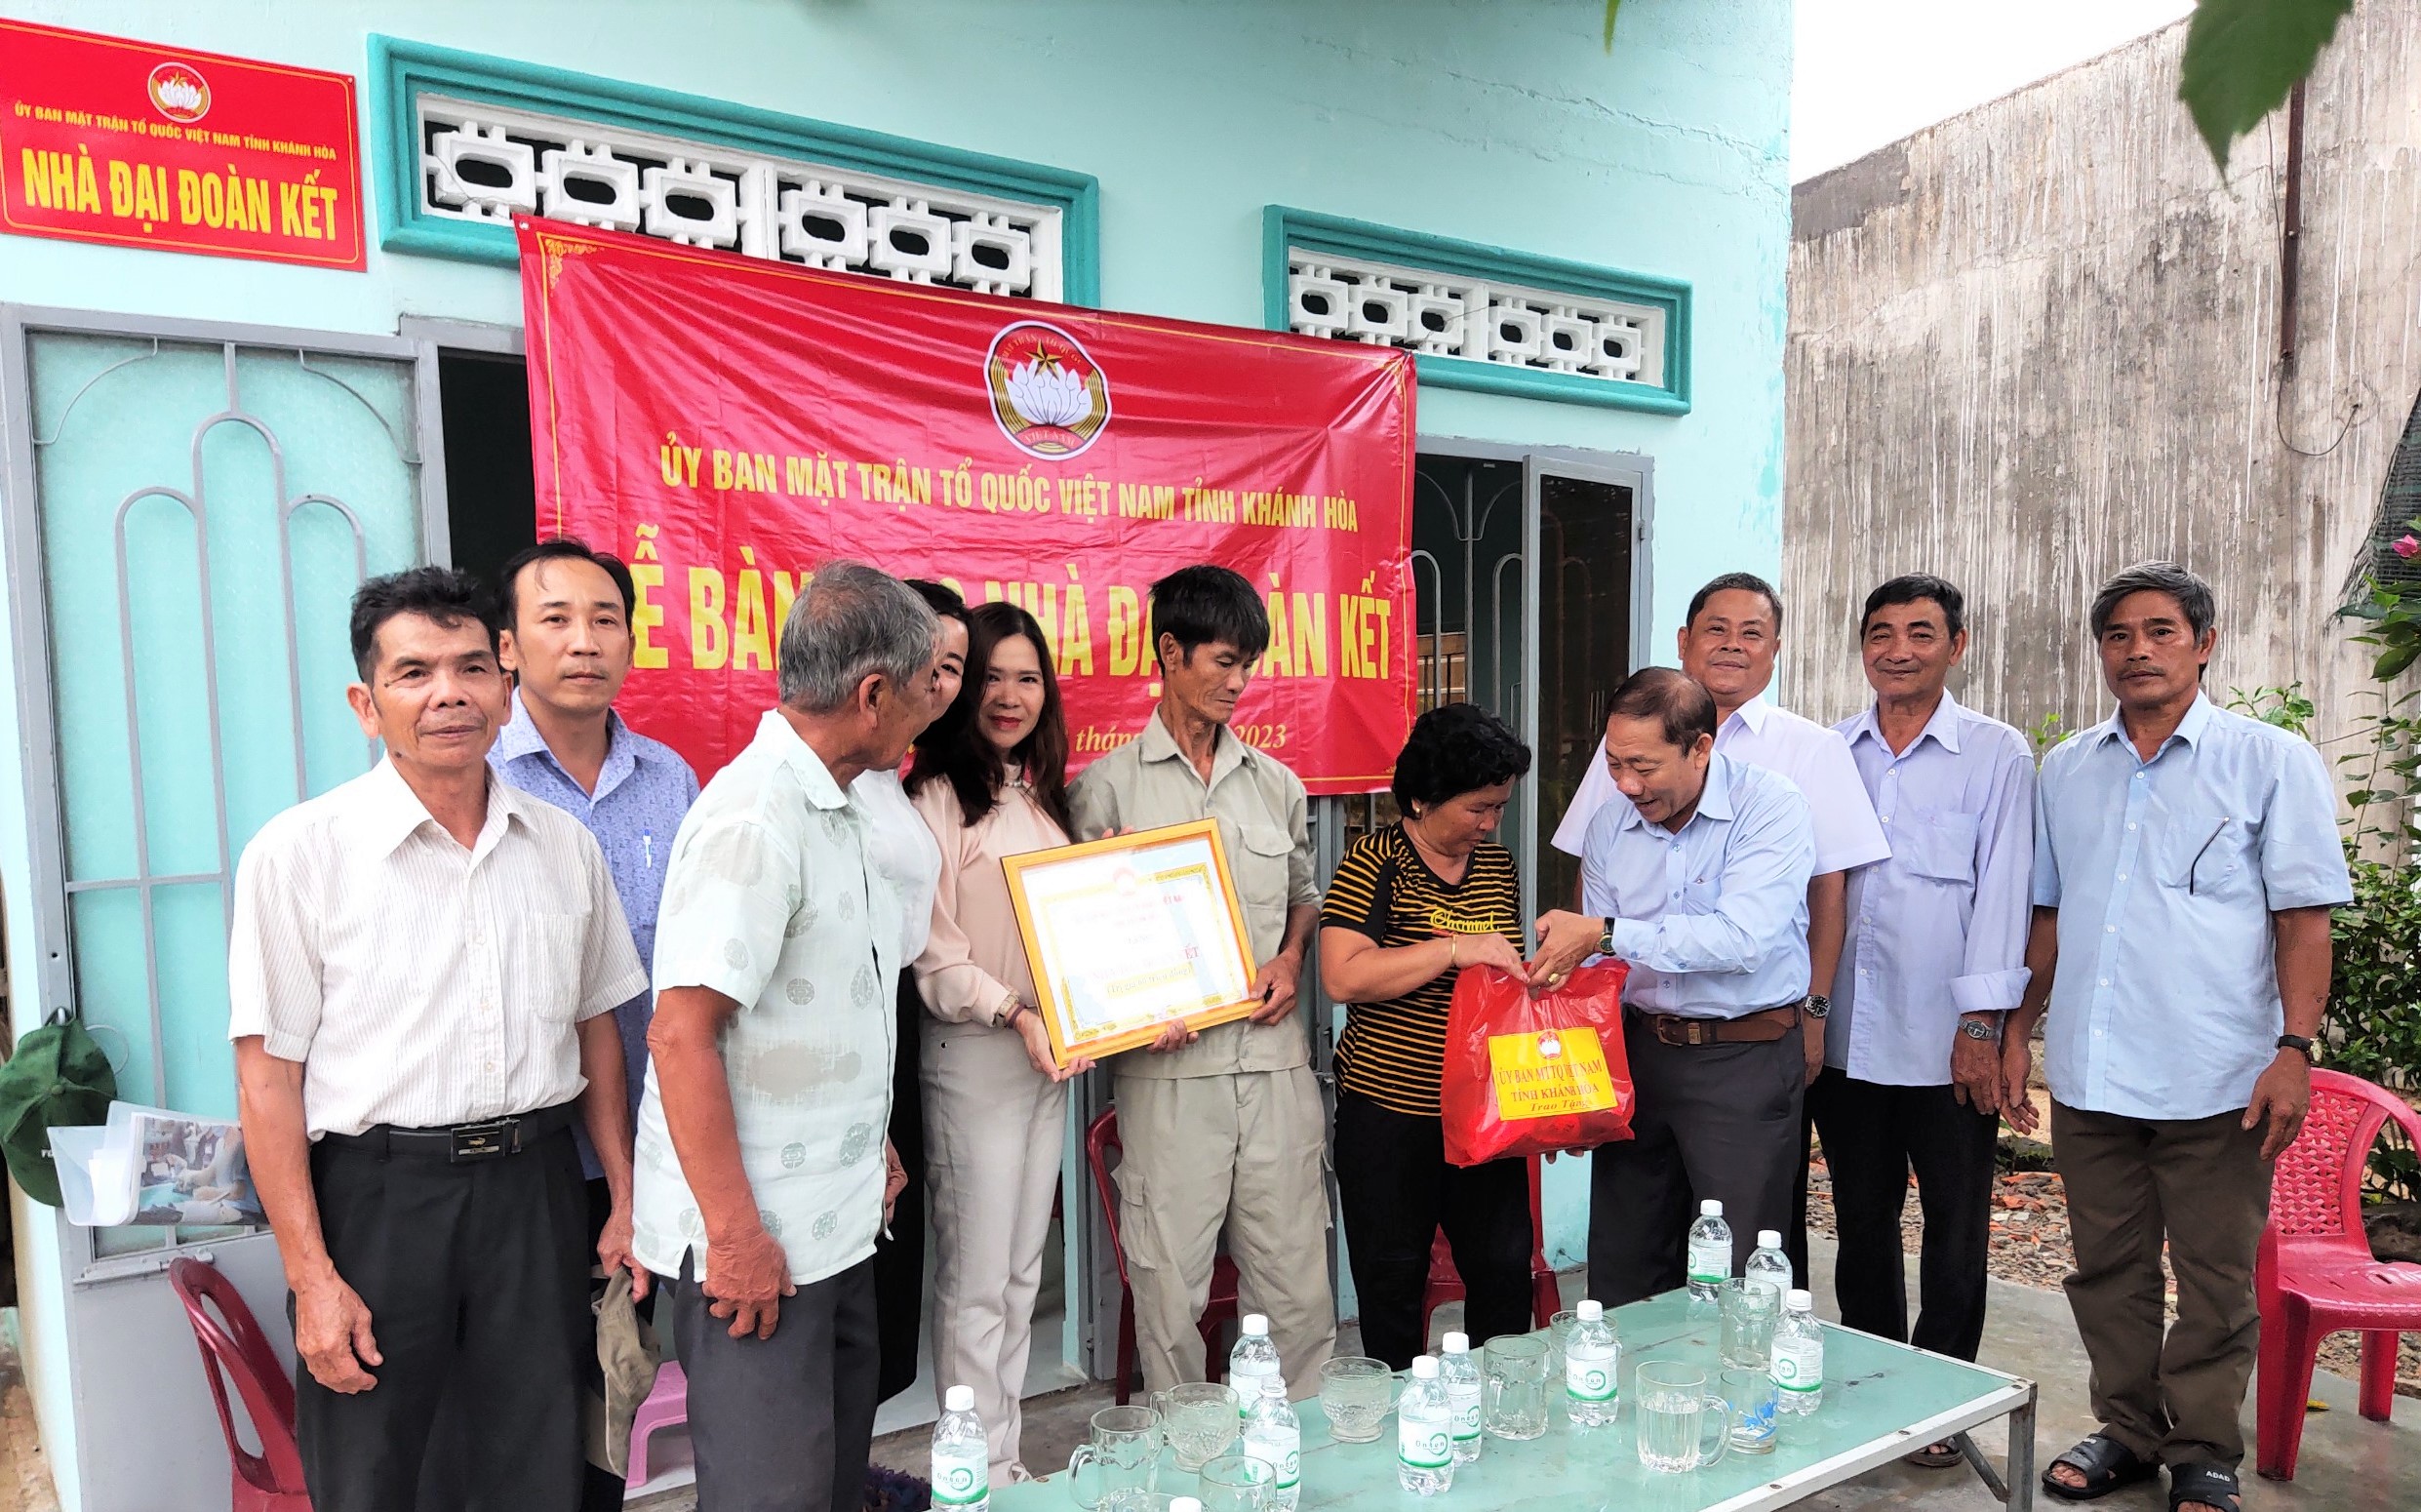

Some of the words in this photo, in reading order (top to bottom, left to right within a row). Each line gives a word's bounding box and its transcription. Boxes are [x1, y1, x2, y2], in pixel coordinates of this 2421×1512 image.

[15, 100, 31, 118] ỦY
[34, 106, 62, 123] BAN
[65, 110, 92, 128] MẶT
[96, 114, 128, 134] TRẬN
[131, 117, 146, 136] TỔ
[149, 123, 181, 140] QUỐC
[184, 127, 210, 145] VIỆT
[213, 132, 241, 147] NAM
[244, 134, 270, 151] TỈNH
[272, 139, 311, 157] KHÁNH
[313, 144, 337, 161] HÒA
[21, 143, 102, 216] NHÀ
[108, 158, 170, 234] ĐẠI
[178, 163, 272, 235] ĐOÀN
[279, 168, 338, 242] KẾT
[660, 431, 702, 488] ỦY
[712, 449, 778, 494] BAN
[785, 451, 849, 507] MẶT
[856, 458, 932, 512] TRẬN
[938, 457, 973, 509] TỔ
[980, 462, 1052, 514] QUỐC
[1057, 472, 1111, 524] VIỆT
[1118, 482, 1175, 521] NAM
[1182, 476, 1236, 524] TỈNH
[1242, 486, 1317, 529] KHÁNH
[1324, 490, 1358, 533] HÒA
[629, 523, 670, 670] Ễ
[984, 563, 1094, 677] HÀ
[1339, 570, 1391, 680] KẾT
[1076, 725, 1139, 752] thán
[1235, 724, 1287, 749] 2023
[1514, 1068, 1534, 1084] BAN
[1579, 1059, 1603, 1075] NAM
[1540, 1084, 1576, 1099] KHÁNH
